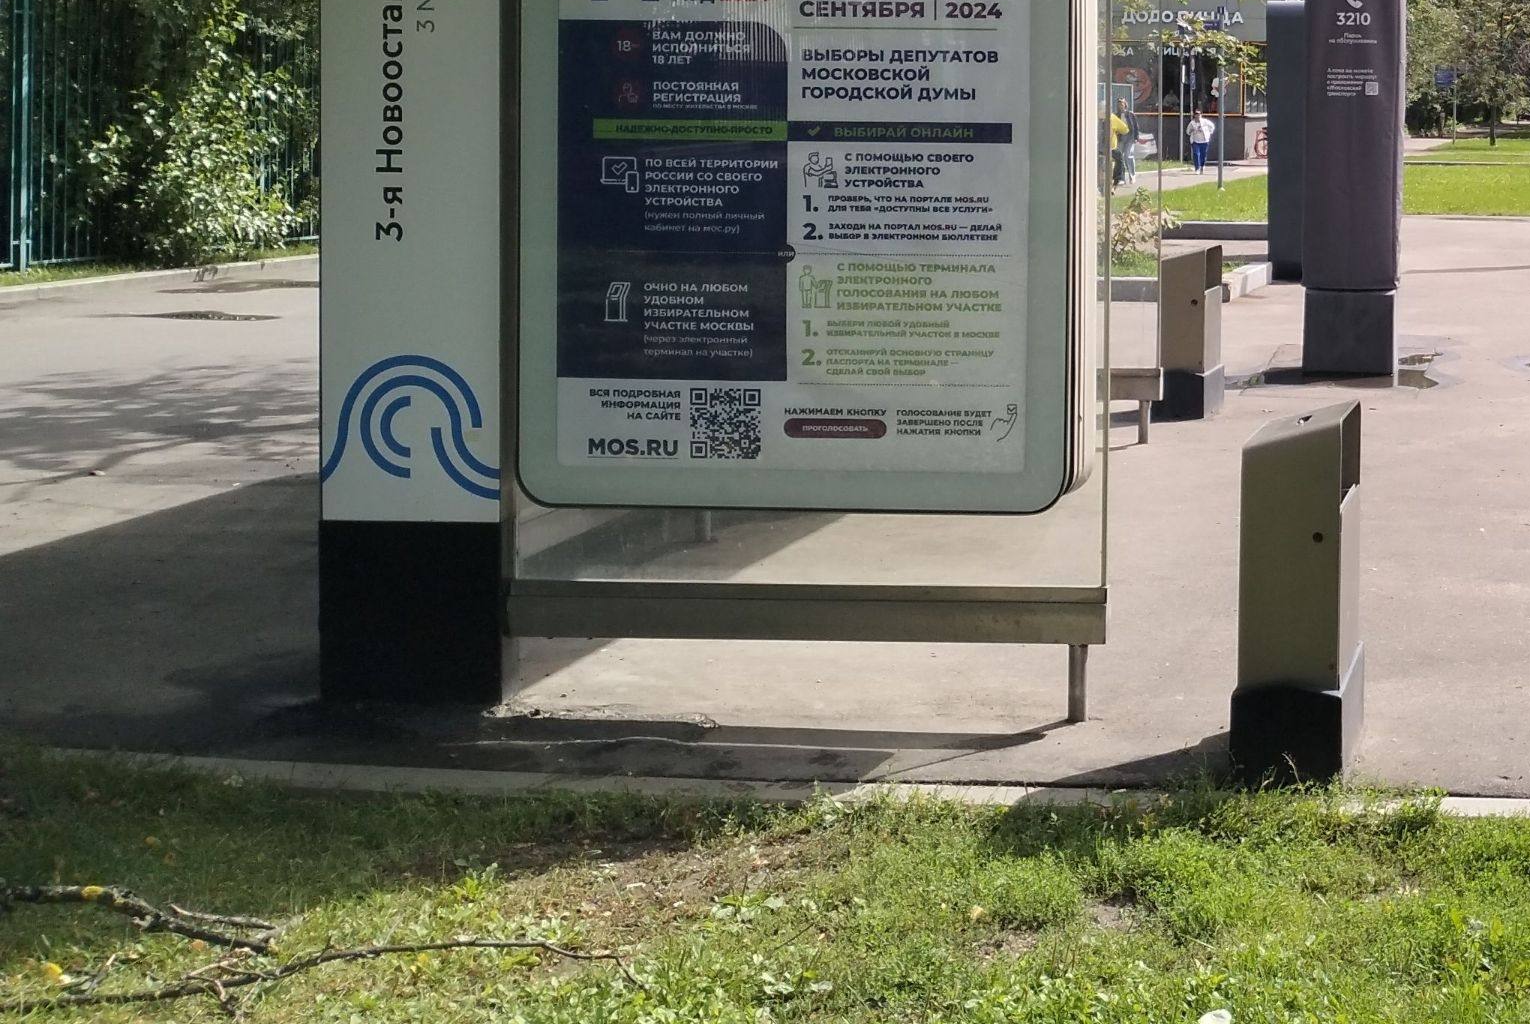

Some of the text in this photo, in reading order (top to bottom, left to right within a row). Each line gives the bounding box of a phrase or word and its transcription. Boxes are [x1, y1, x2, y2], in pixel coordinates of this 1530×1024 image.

[799, 0, 1003, 19] СЕНТЯБРЯ 2024
[1121, 9, 1174, 25] ДОДО
[1336, 12, 1371, 26] 3210
[416, 19, 436, 33] 3
[652, 31, 746, 42] ВАМ ДОЛЖНО
[652, 55, 692, 65] 18 ЛЕТ
[802, 49, 999, 64] ВЫБОРЫ ДЕПУТАТОВ
[801, 66, 930, 81] МОСКОВСКОЙ
[653, 81, 740, 91] ПОСТОЯННАЯ
[653, 93, 742, 104] РЕГИСТРАЦИЯ
[801, 85, 976, 102] ГОРОДСКОЙ ДУМЫ
[834, 125, 974, 138] ВЫБИРАЙ ОНЛАЙН
[645, 157, 778, 169] ПО ВСЕЙ ТЕРРИТОРИИ
[844, 153, 974, 164] С ПОМОЩЬЮ СВОЕГО
[844, 166, 941, 176] ЭЛЕКТРОННОГО
[645, 172, 763, 182] РОССИИ СО СВОЕГО
[844, 178, 924, 188] УСТРОЙСТВА
[644, 184, 740, 194] ЭЛЕКТРОННОГО
[644, 196, 723, 207] УСТРОЙСТВА
[802, 194, 819, 213] 1.
[828, 195, 872, 204] ПРОВЕРЬ,
[954, 196, 989, 204] MOS.RU
[827, 205, 847, 213] ДЛЯ
[375, 187, 404, 243] 3-я
[644, 211, 766, 220] (нужен полный личный
[644, 223, 685, 232] кабинет
[802, 222, 824, 241] 2.
[829, 223, 866, 231] ЗАХОДИ
[969, 223, 1002, 232] ДЕЛАЙ
[871, 233, 939, 241] ЭЛЕКТРОННОМ
[941, 233, 998, 241] БЮЛЛЕТЕНЕ
[837, 262, 996, 273] С ПОМОЩЬЮ ТЕРМИНАЛА
[837, 276, 932, 286] ЭЛЕКТРОННОГО
[643, 283, 748, 293] ОЧНО НА ЛЮБОМ
[837, 289, 999, 300] ГОЛОСОВАНИЯ НА ЛЮБОМ
[643, 296, 704, 306] УДОБНОМ
[836, 302, 1002, 312] ИЗБИРАТЕЛЬНОМ УЧАСТКЕ
[643, 308, 750, 318] ИЗБИРАТЕЛЬНОМ
[643, 321, 755, 331] УЧАСТКЕ МОСКВЫ
[802, 319, 819, 337] 1.
[643, 335, 748, 345] (через электронный
[643, 349, 753, 359] терминал на участке)
[801, 348, 822, 366] 2.
[589, 388, 681, 399] ВСЯ ПОДРОБНАЯ
[600, 400, 681, 410] ИНФОРМАЦИЯ
[627, 410, 681, 421] НА САЙТЕ
[784, 408, 887, 417] НАЖИМАЕМ КНОПКУ
[896, 409, 993, 418] ГОЛОСОВАНИЕ БУДЕТ
[953, 419, 984, 427] ПОСЛЕ
[896, 428, 982, 437] НАЖАТИЯ КНОПКИ
[587, 437, 679, 457] MOS.RU
